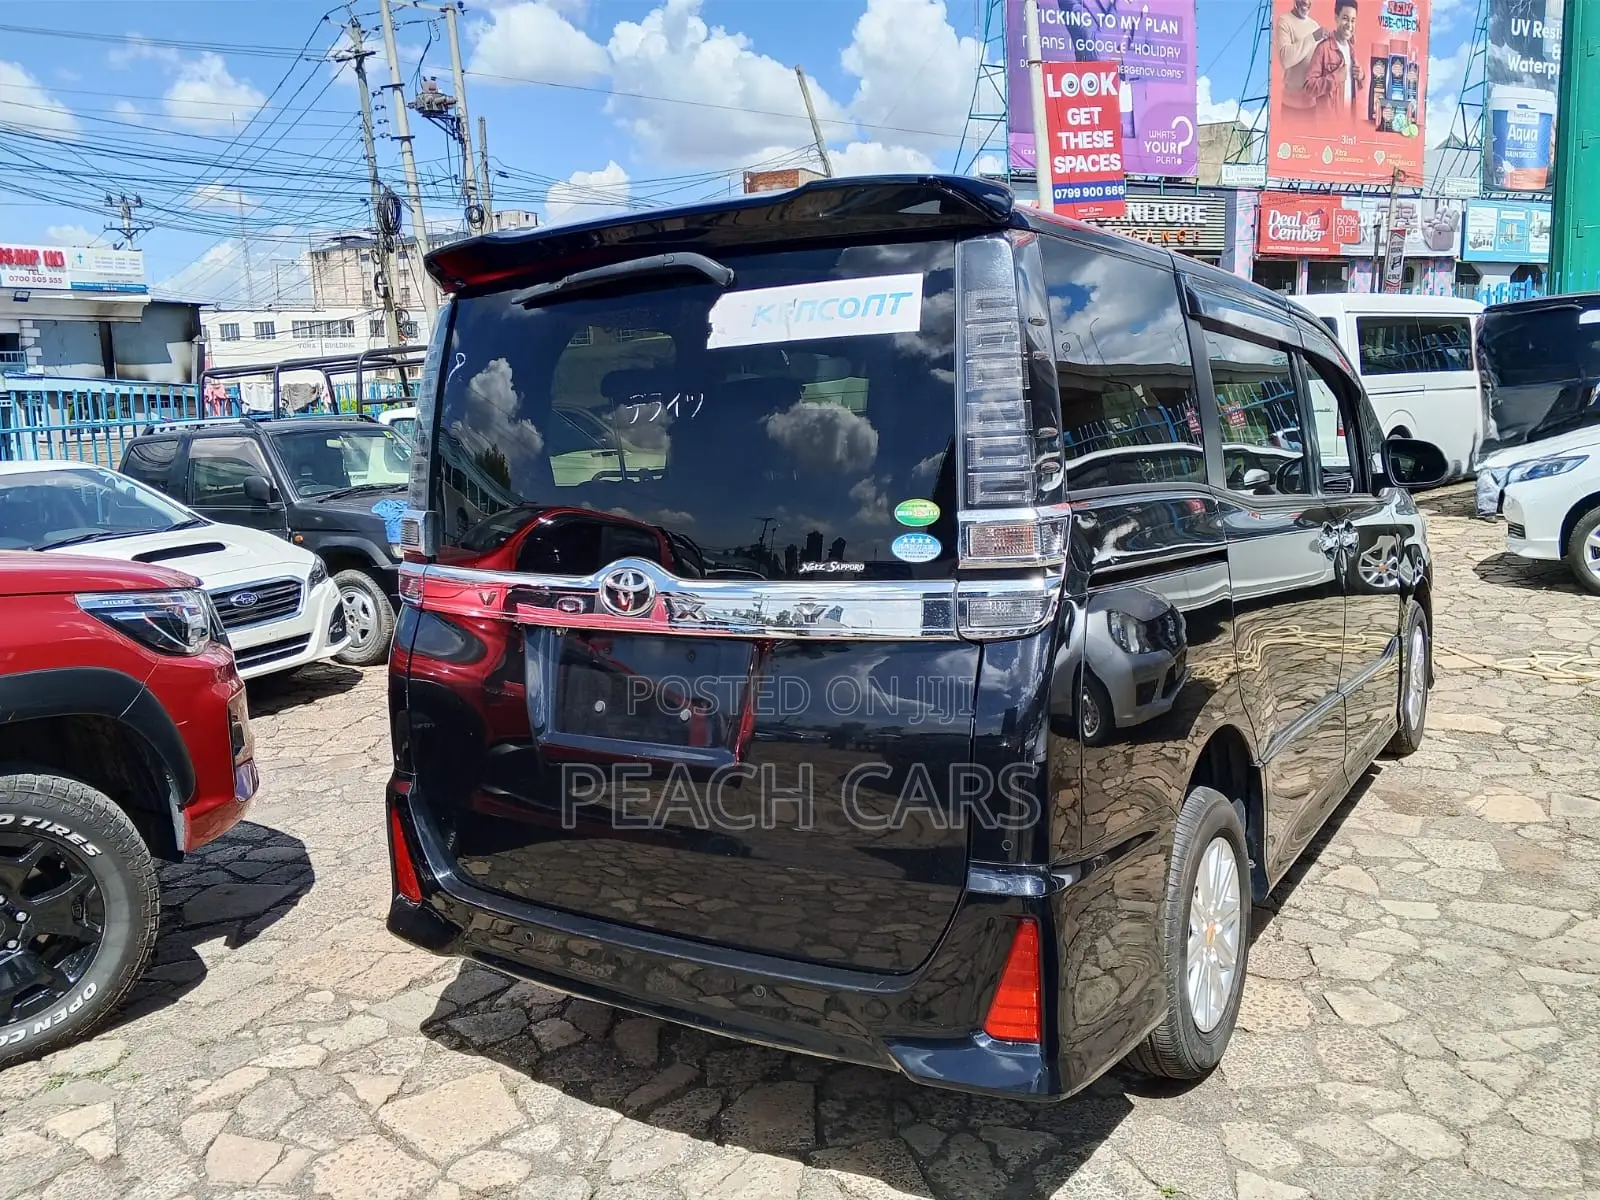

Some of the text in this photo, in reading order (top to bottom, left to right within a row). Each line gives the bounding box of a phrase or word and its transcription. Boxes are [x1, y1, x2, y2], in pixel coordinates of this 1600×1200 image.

[1099, 13, 1116, 30] TO
[1120, 17, 1141, 31] MY
[1145, 20, 1178, 35] PLAN
[1511, 17, 1530, 37] UV
[1076, 38, 1126, 54] GOOGLE
[1046, 72, 1118, 98] LOOK
[1066, 106, 1102, 126] GET
[1057, 129, 1114, 150] THESE
[1507, 123, 1539, 145] Aqua
[1144, 140, 1177, 155] YOUR
[1292, 144, 1307, 154] Rich
[1053, 153, 1122, 174] SPACES
[1054, 188, 1081, 200] 0799
[1082, 186, 1104, 198] 900
[1268, 210, 1301, 228] Deal
[1269, 224, 1327, 242] Cember
[1336, 226, 1356, 238] OFF
[20, 815, 104, 857] TIRES
[32, 981, 98, 1036] OPEN
